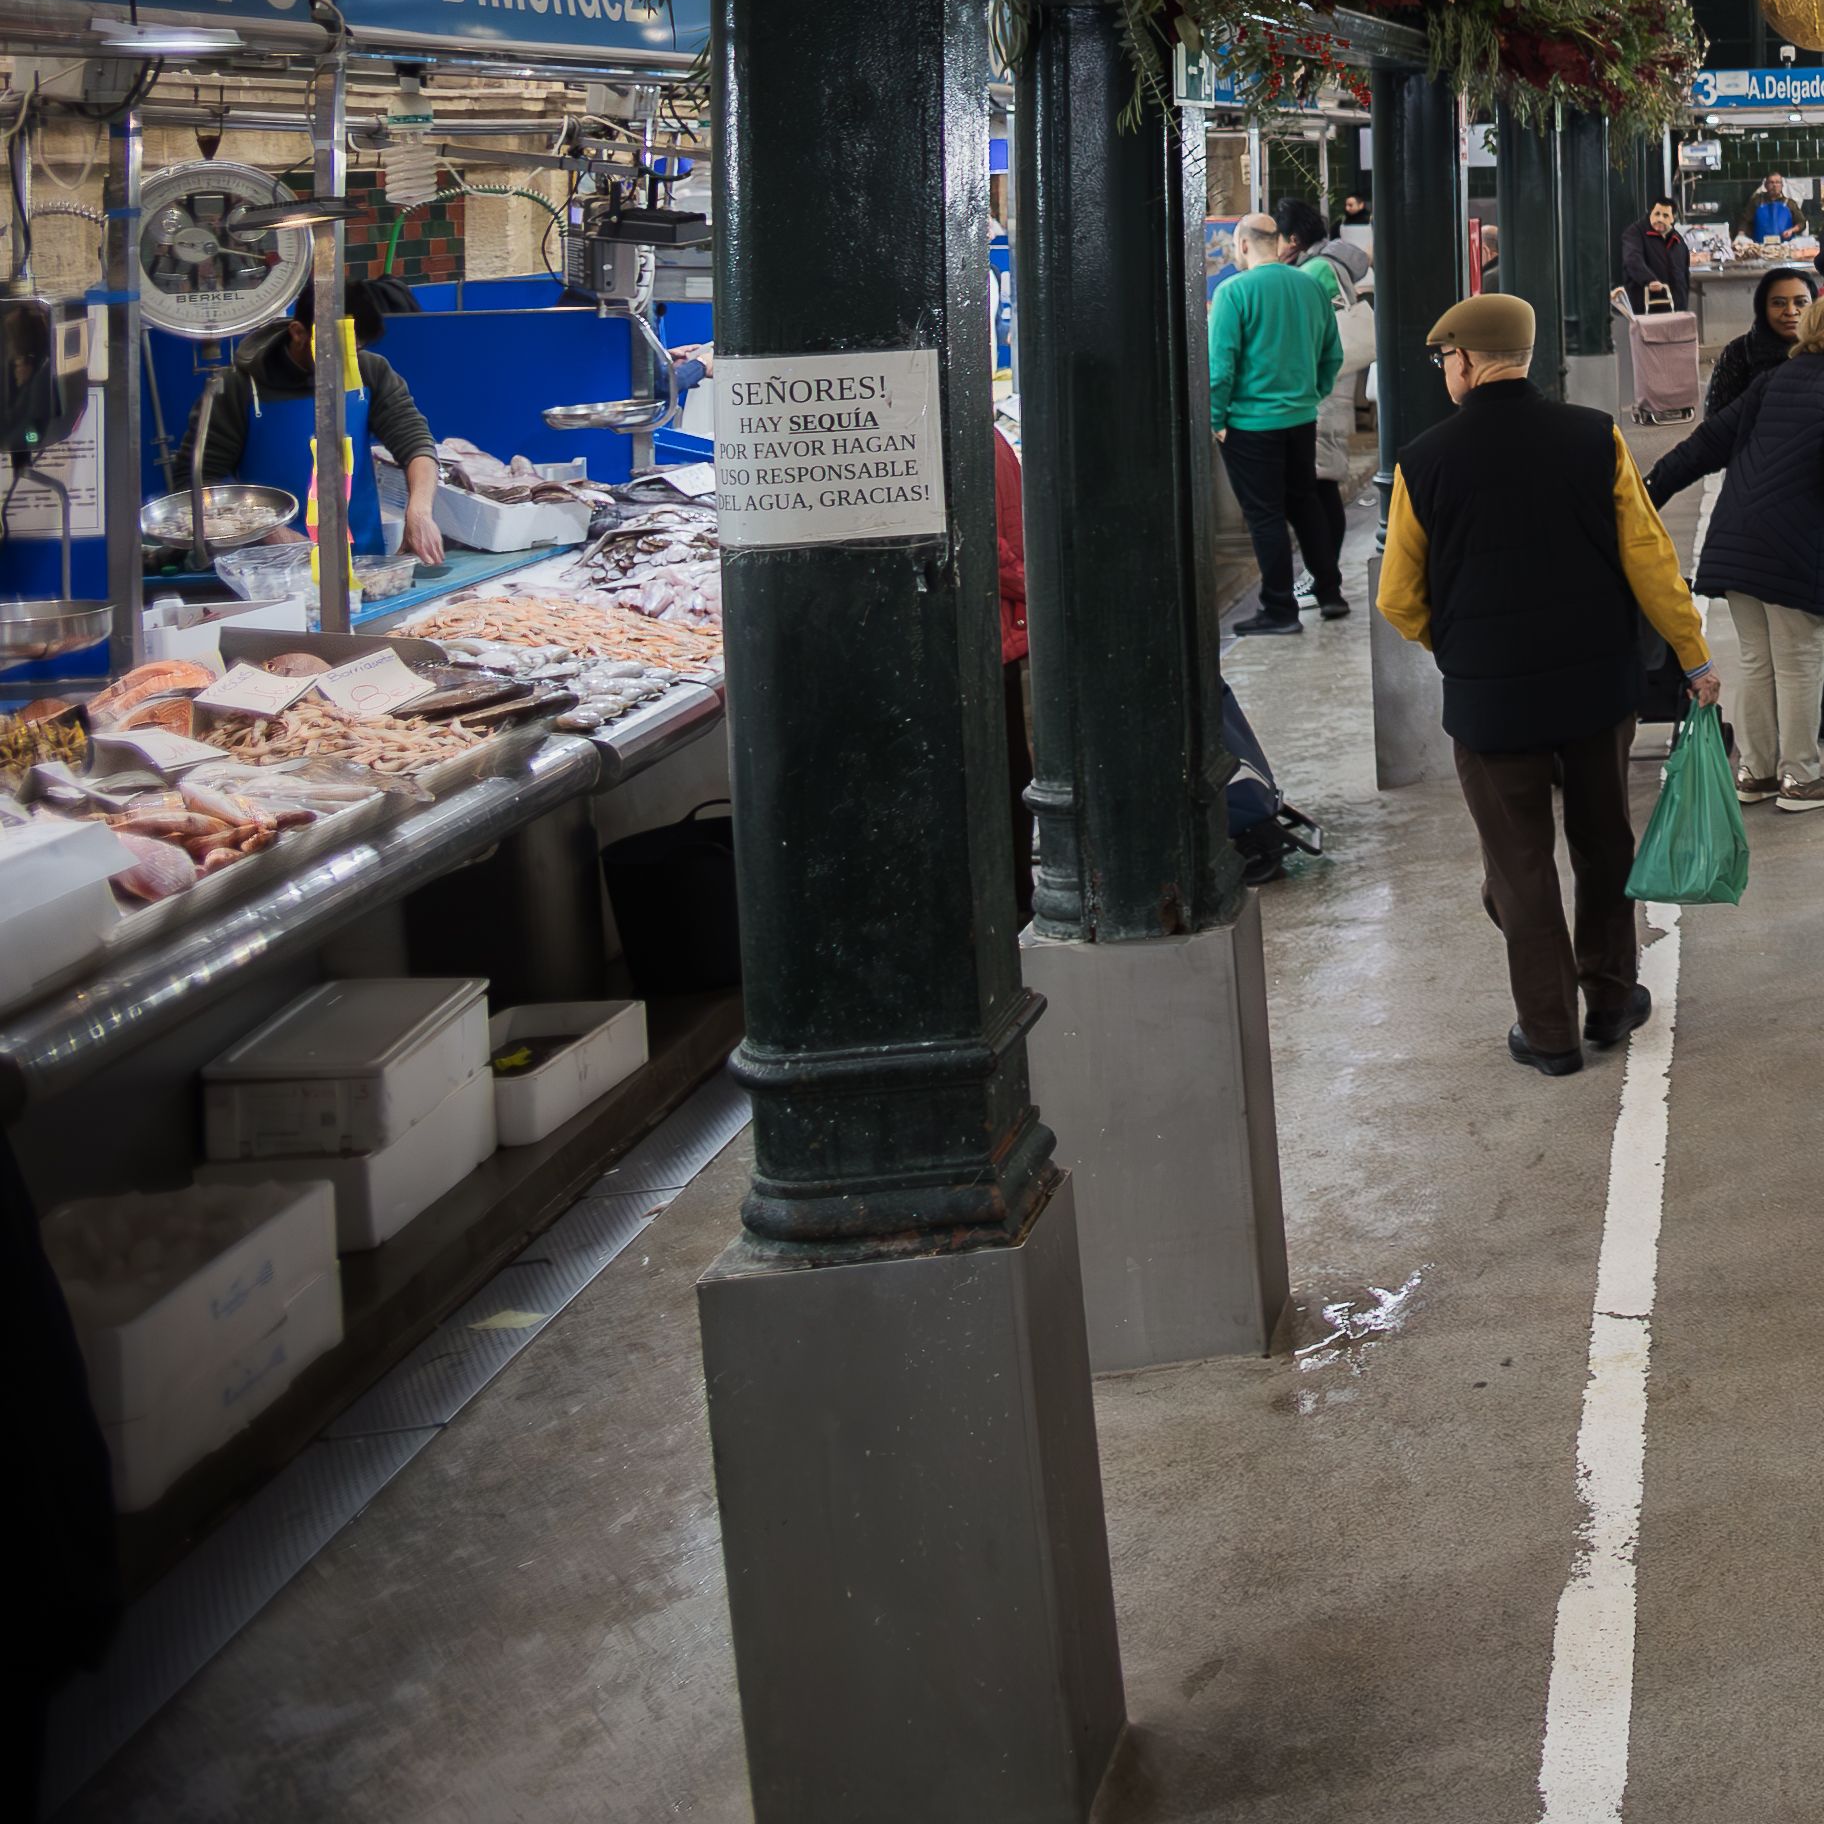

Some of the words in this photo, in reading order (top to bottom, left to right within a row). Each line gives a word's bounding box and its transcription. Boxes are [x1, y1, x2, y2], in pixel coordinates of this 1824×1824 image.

[1697, 73, 1718, 106] 3
[176, 292, 245, 304] BERKEL
[731, 375, 887, 407] SEÑORES!
[740, 416, 783, 434] HAY
[788, 407, 880, 434] SEQUÍA
[719, 442, 748, 460] POR
[754, 439, 825, 459] FAVOR
[832, 433, 917, 456] HAGAN
[720, 468, 750, 486] USO
[756, 459, 919, 486] RESPONSABLE
[718, 493, 742, 511] DEL
[745, 491, 814, 512] AGUA,
[819, 484, 931, 509] GRACIAS!
